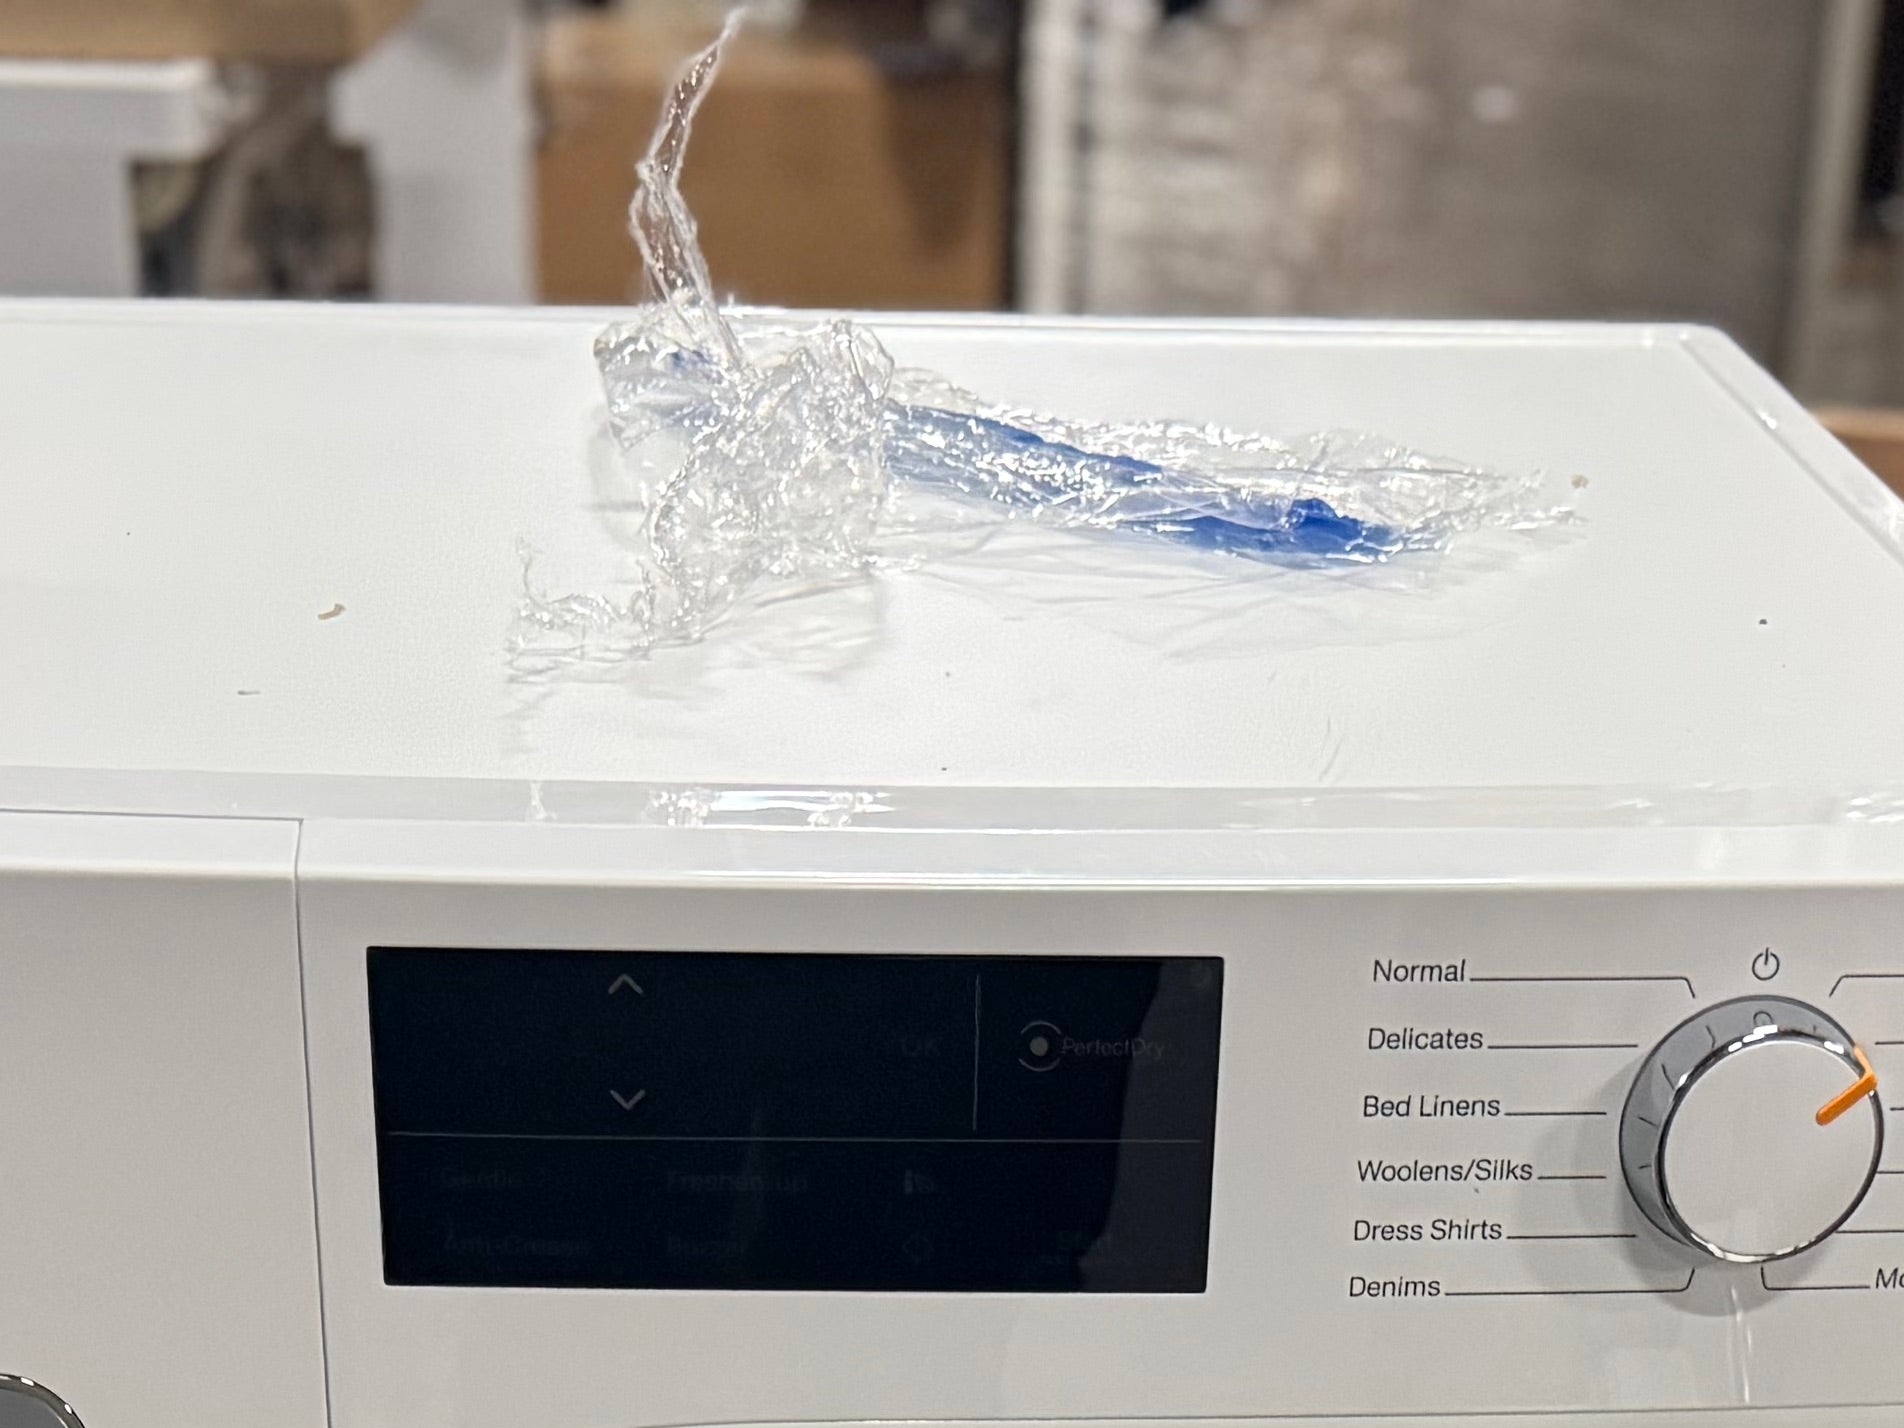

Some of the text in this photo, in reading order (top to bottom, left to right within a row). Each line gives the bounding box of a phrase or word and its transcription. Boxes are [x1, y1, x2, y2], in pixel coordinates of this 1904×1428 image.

[1373, 958, 1466, 983] Normal
[1368, 1027, 1484, 1050] Delicates
[1363, 1094, 1501, 1118] Bed Linens
[1357, 1158, 1533, 1182] Woolens/Silks
[1354, 1218, 1502, 1241] Dress Shirts
[1349, 1275, 1441, 1298] Denims
